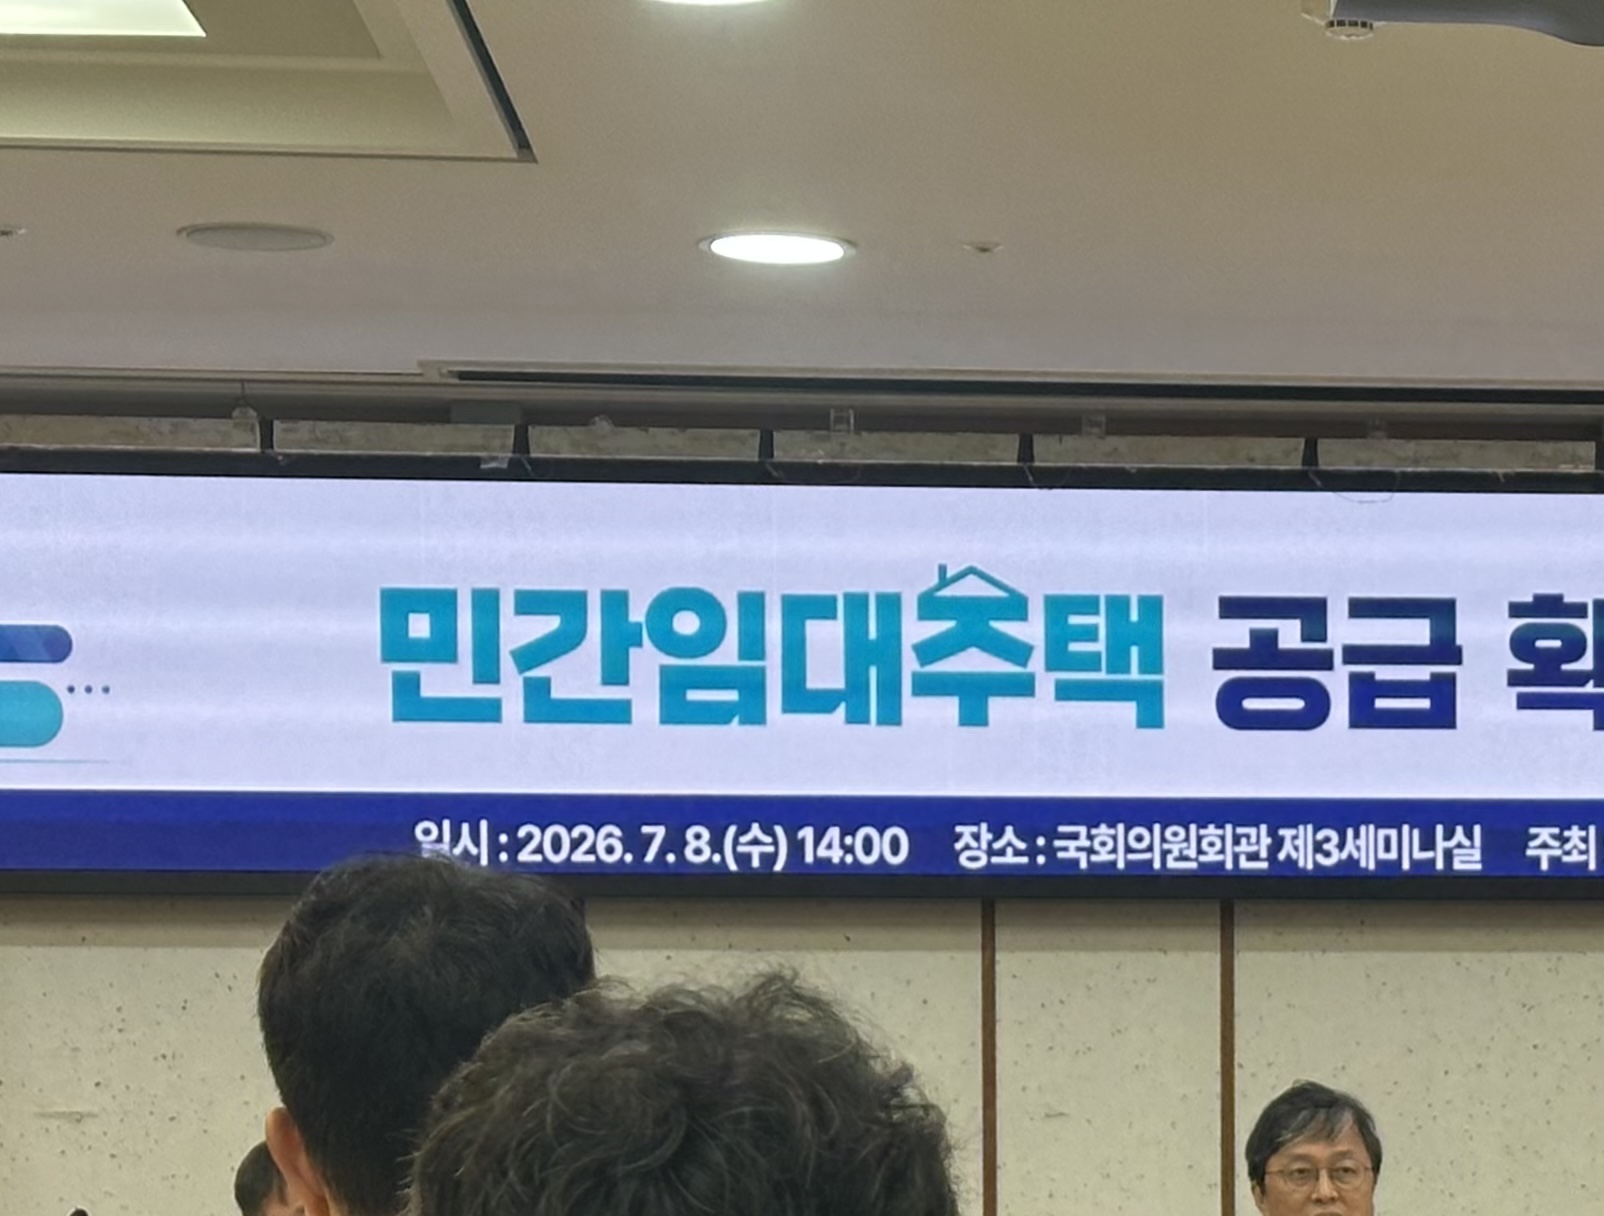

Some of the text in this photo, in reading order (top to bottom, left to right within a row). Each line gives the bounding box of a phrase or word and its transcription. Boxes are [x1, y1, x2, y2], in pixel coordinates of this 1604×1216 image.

[379, 563, 1165, 730] 민간임대주택
[1211, 595, 1464, 732] 공급
[516, 823, 634, 864] 2026.
[797, 826, 910, 866] 14:00
[953, 822, 1030, 870] 장소
[1052, 822, 1270, 871] 국회의원회관
[1277, 823, 1483, 871] 제3세미나실
[1525, 824, 1597, 872] 주최
